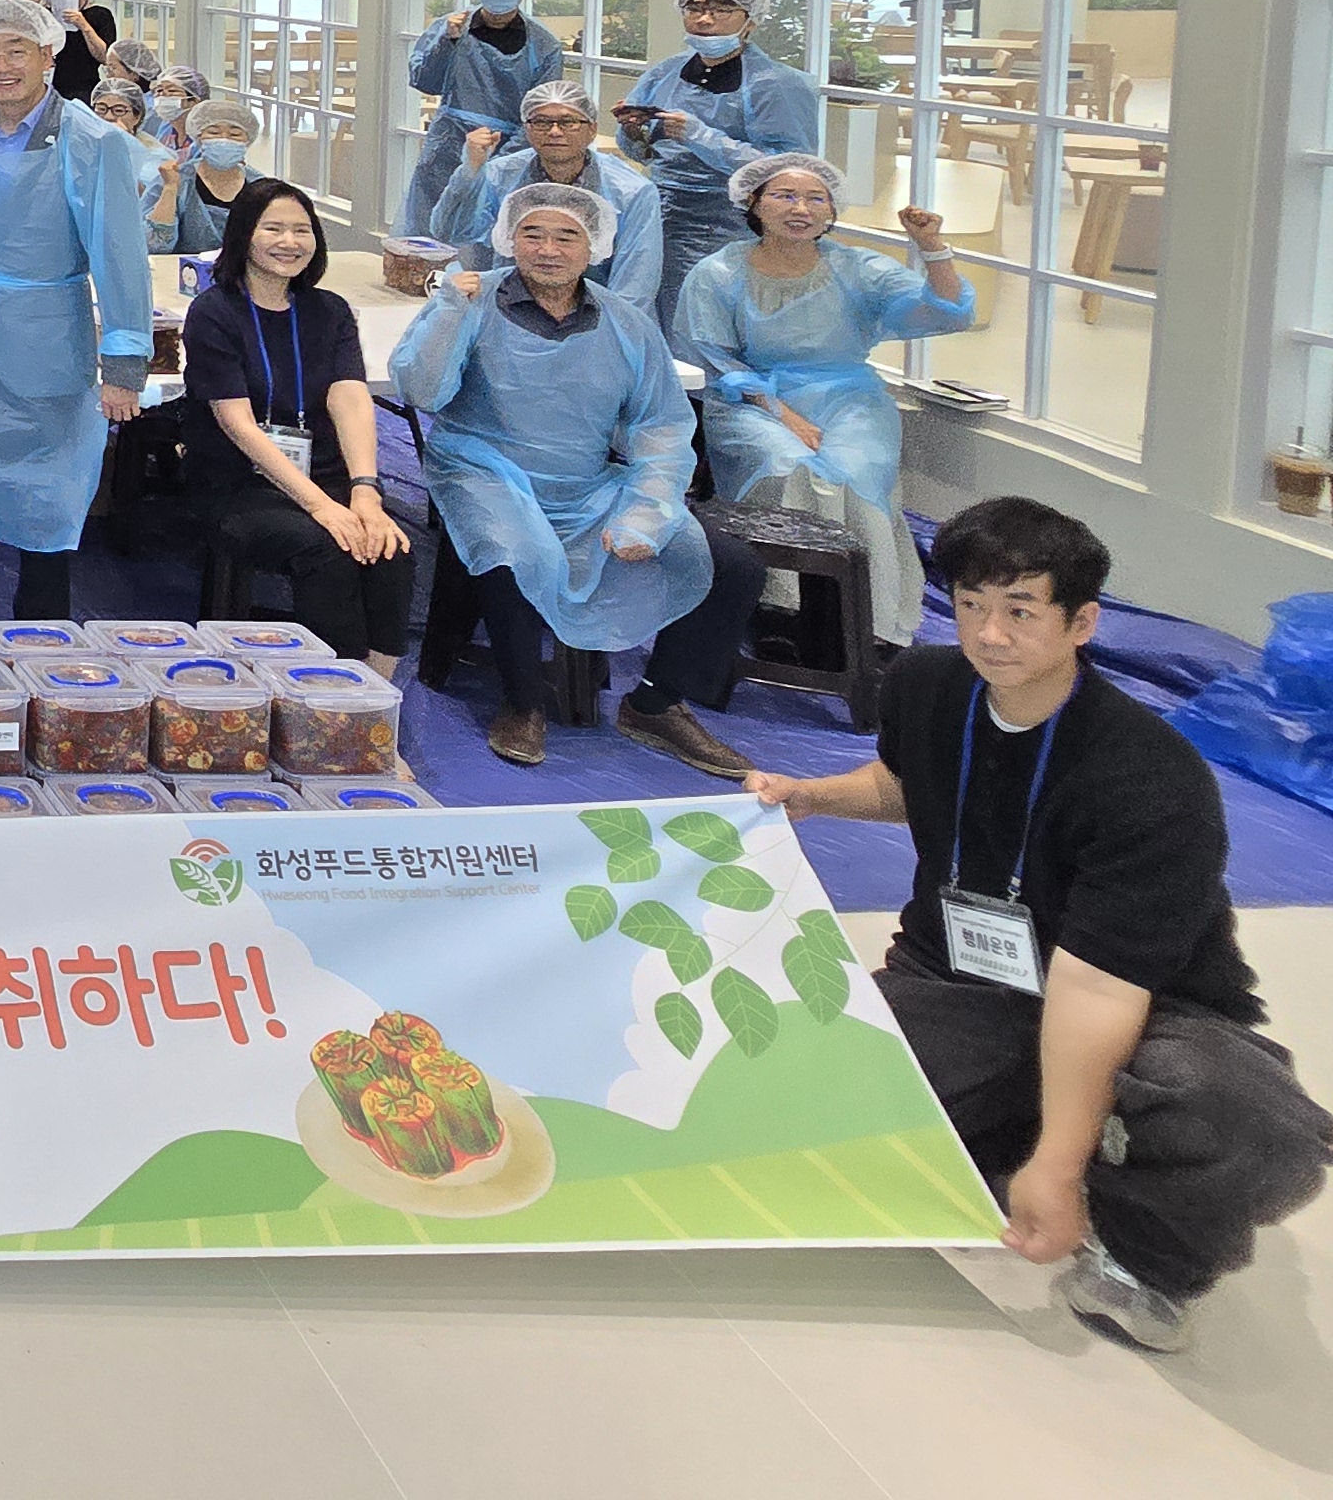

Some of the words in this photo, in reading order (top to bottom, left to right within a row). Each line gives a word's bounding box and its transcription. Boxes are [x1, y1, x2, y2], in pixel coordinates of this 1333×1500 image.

[256, 843, 539, 881] 화성푸드통합지원센터
[261, 888, 329, 903] Hwaseong
[333, 887, 366, 901] Food
[369, 886, 441, 902] Integration
[444, 885, 496, 900] Support
[498, 883, 541, 897] Center
